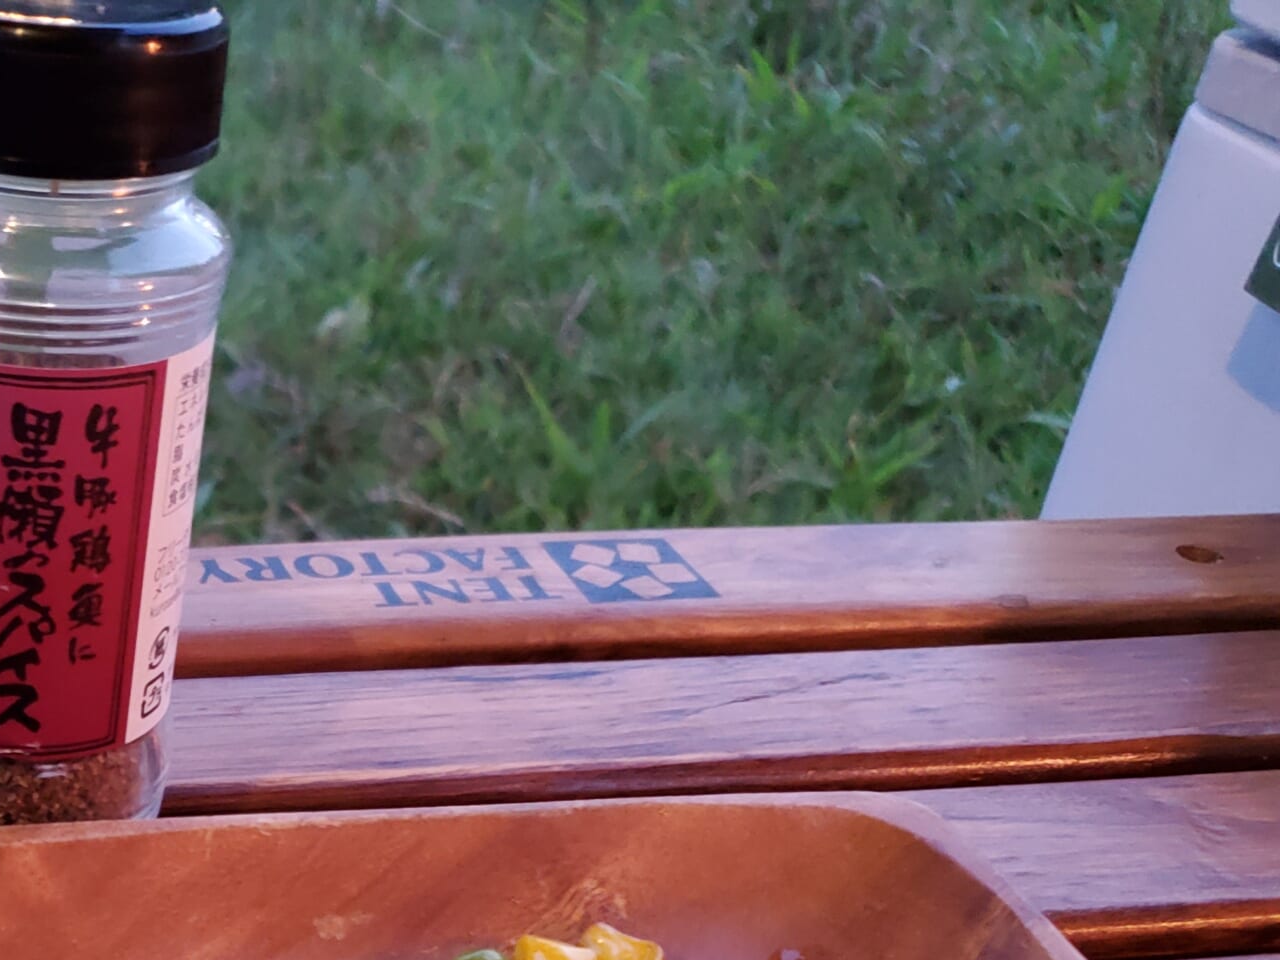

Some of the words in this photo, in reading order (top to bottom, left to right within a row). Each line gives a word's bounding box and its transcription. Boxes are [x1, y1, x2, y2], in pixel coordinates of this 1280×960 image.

[68, 403, 119, 664] 牛豚鶏魚に
[199, 546, 533, 585] FACTORY
[375, 575, 563, 608] TENT
